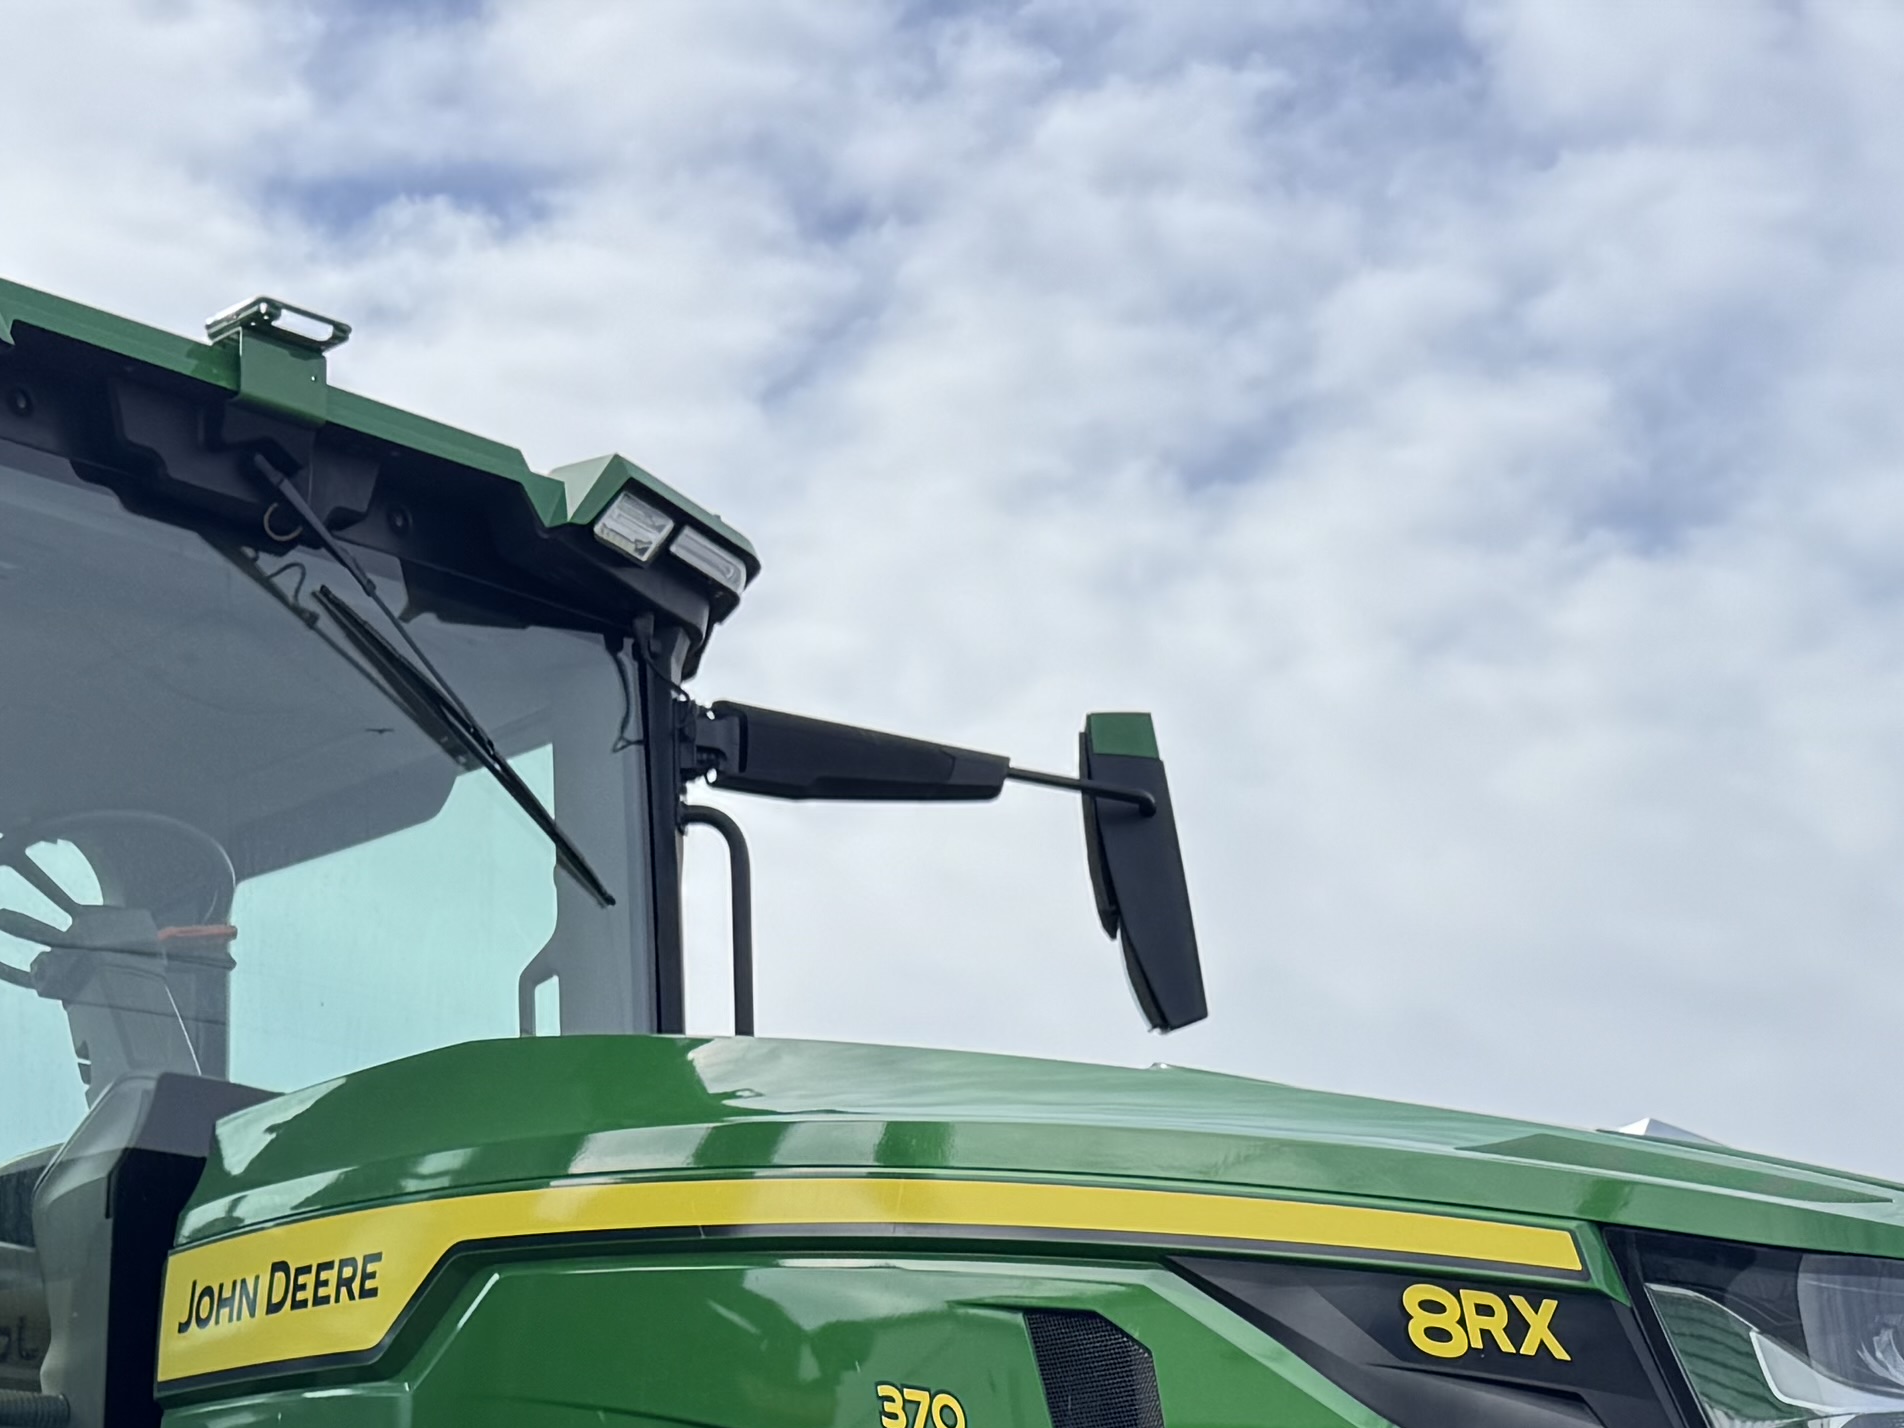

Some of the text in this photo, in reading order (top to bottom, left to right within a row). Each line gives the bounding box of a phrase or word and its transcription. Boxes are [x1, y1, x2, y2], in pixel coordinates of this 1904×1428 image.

[177, 1252, 383, 1334] JOHN DEERE
[1402, 1284, 1571, 1361] 8RX
